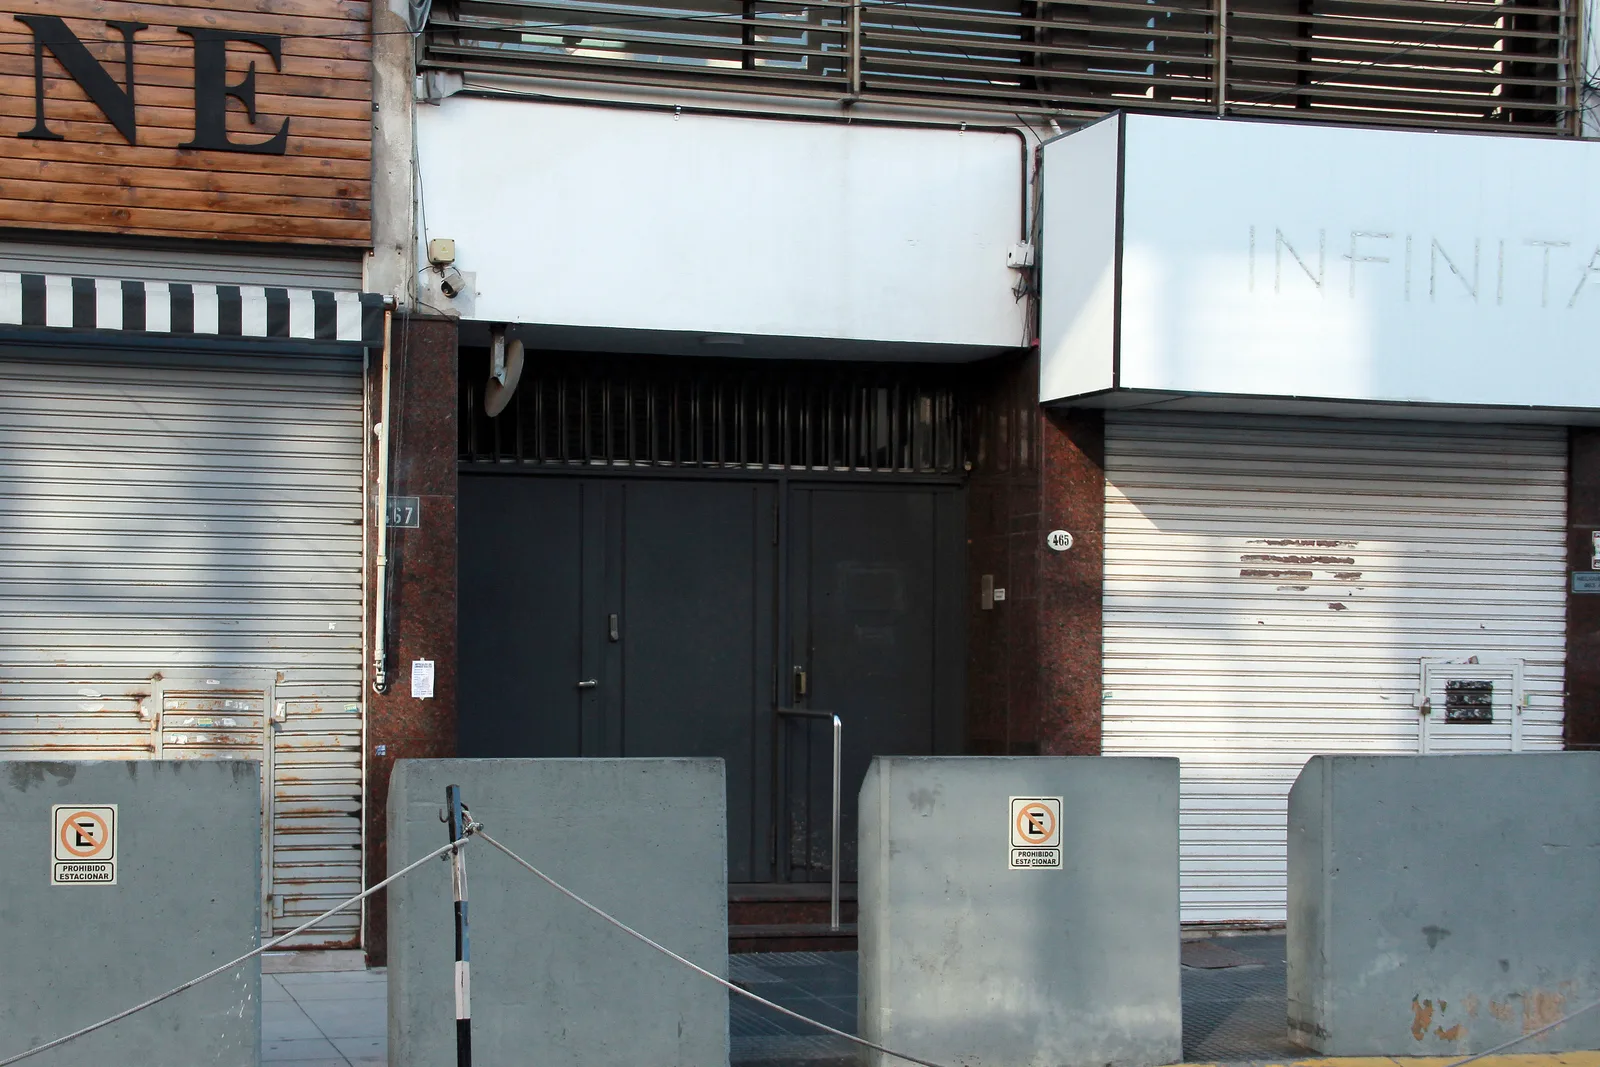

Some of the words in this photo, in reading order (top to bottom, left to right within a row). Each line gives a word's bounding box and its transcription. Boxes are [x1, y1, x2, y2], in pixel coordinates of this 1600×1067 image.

[13, 14, 291, 154] NE
[386, 506, 413, 524] 67
[1053, 534, 1069, 546] 465
[62, 864, 106, 872] PROHIBIDO
[1015, 858, 1057, 866] ESTACIONAR
